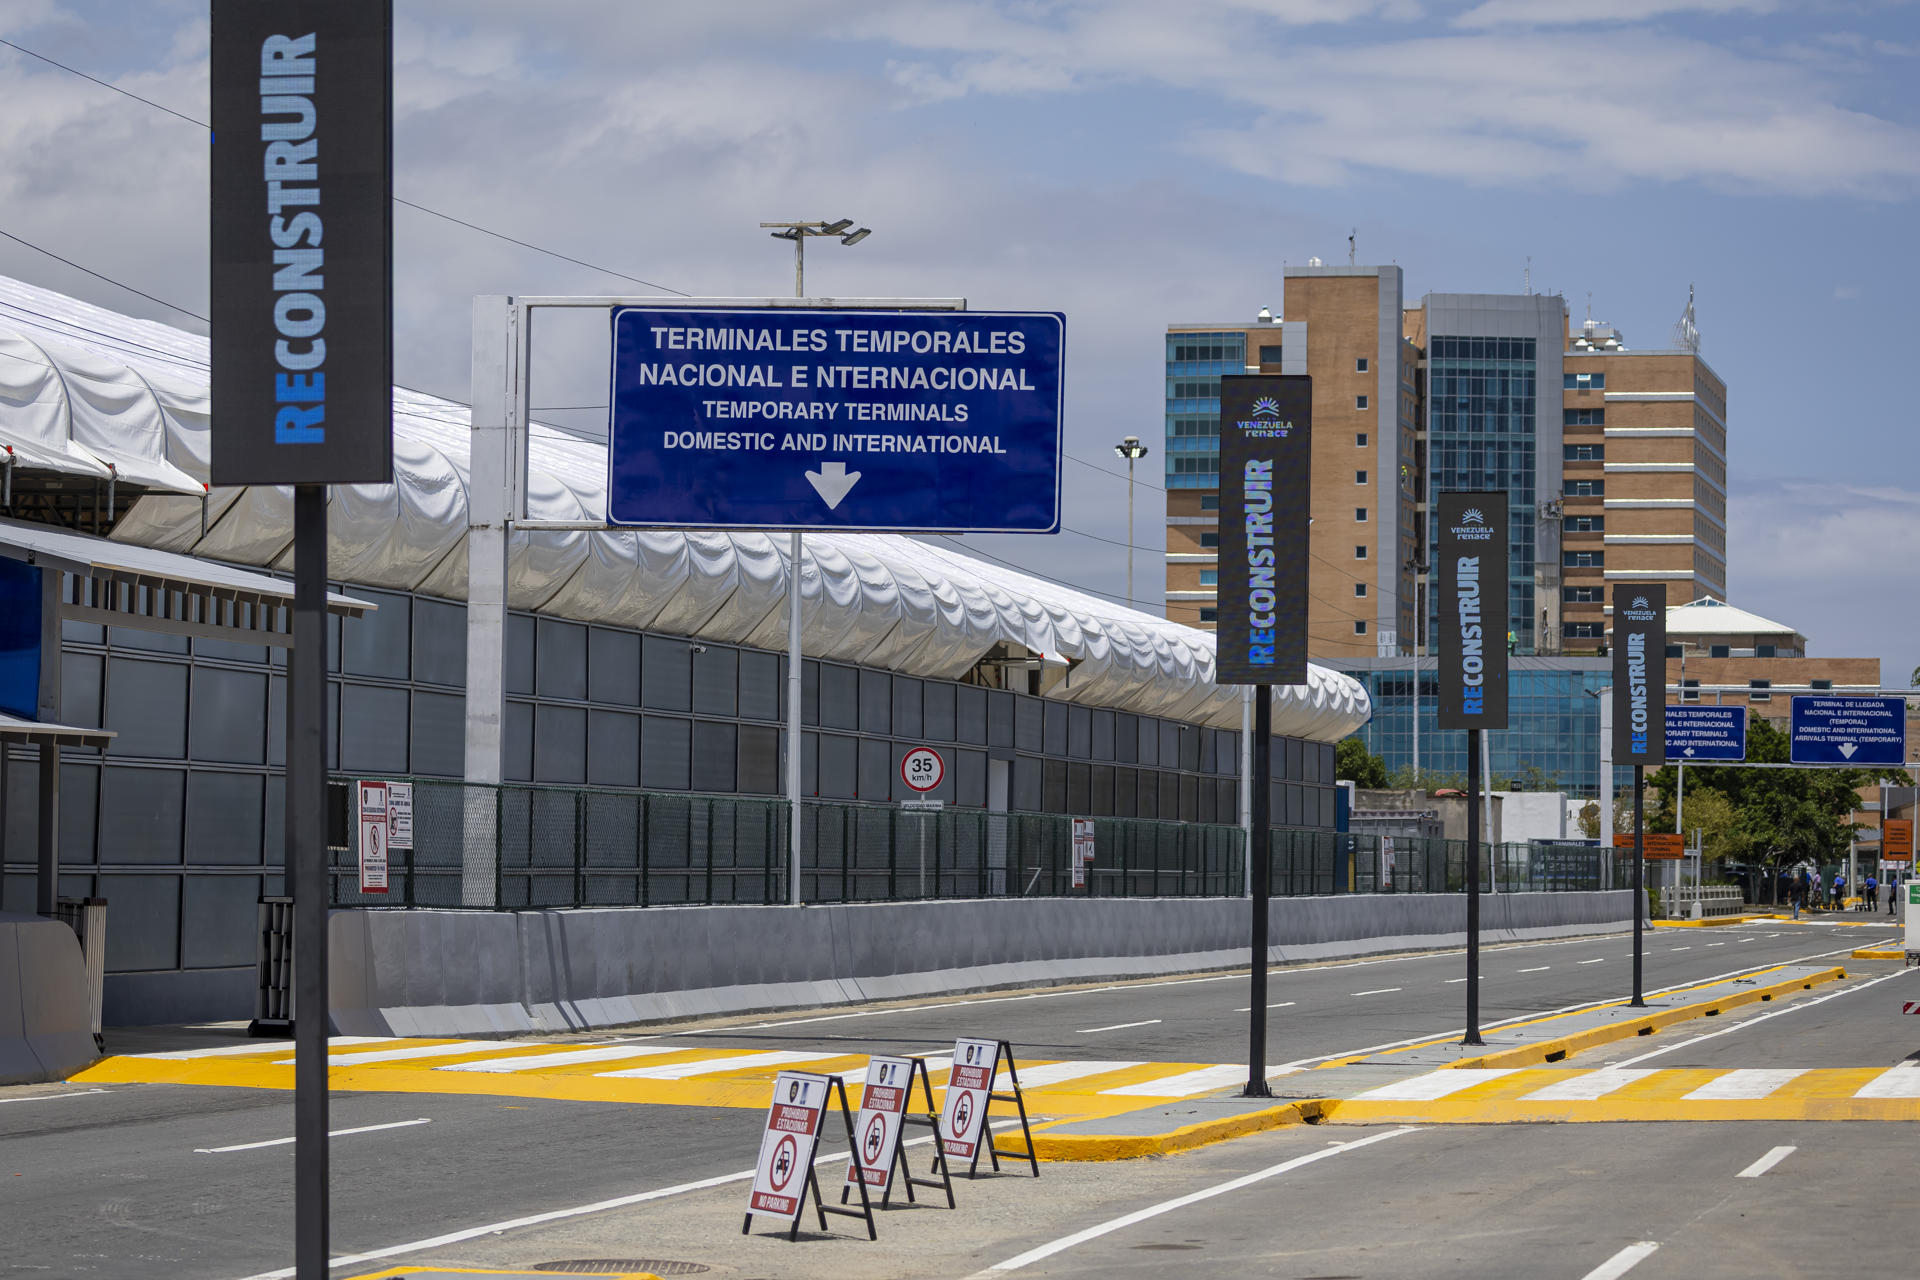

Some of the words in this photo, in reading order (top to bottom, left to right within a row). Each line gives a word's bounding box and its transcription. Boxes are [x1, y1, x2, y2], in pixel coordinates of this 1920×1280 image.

[259, 32, 326, 444] RECONSTRUIR
[650, 327, 828, 351] TERMINALES
[835, 329, 1026, 354] TEMPORALES
[639, 363, 783, 387] NACIONAL
[791, 365, 808, 388] E
[816, 366, 1036, 391] NTERNACIONAL
[702, 400, 839, 420] TEMPORARY
[844, 402, 969, 422] TERMINALS
[1236, 421, 1293, 429] VENEZUELA
[1245, 430, 1288, 438] renace
[663, 431, 775, 451] DOMESTIC
[780, 433, 827, 451] AND
[832, 433, 1007, 454] INTERNATIONAL
[1244, 459, 1277, 664] RECONSTRUIR
[1456, 555, 1484, 714] RECONSTRUIR
[1627, 632, 1648, 754] RECONSTRUIR
[1829, 718, 1867, 726] (TEMPORAL)
[912, 758, 932, 772] 35
[912, 774, 931, 782] km/h
[960, 1066, 983, 1078] PROHIBIDO
[956, 1076, 982, 1088] ESTACIONAR
[873, 1087, 896, 1100] PROHIBIDO
[869, 1098, 895, 1110] ESTACIONAR
[781, 1106, 809, 1120] PROHIBIDO
[776, 1118, 809, 1133] ESTACIONAR
[950, 1142, 968, 1154] PARKING
[758, 1194, 767, 1208] NO
[765, 1196, 789, 1211] PARKING
